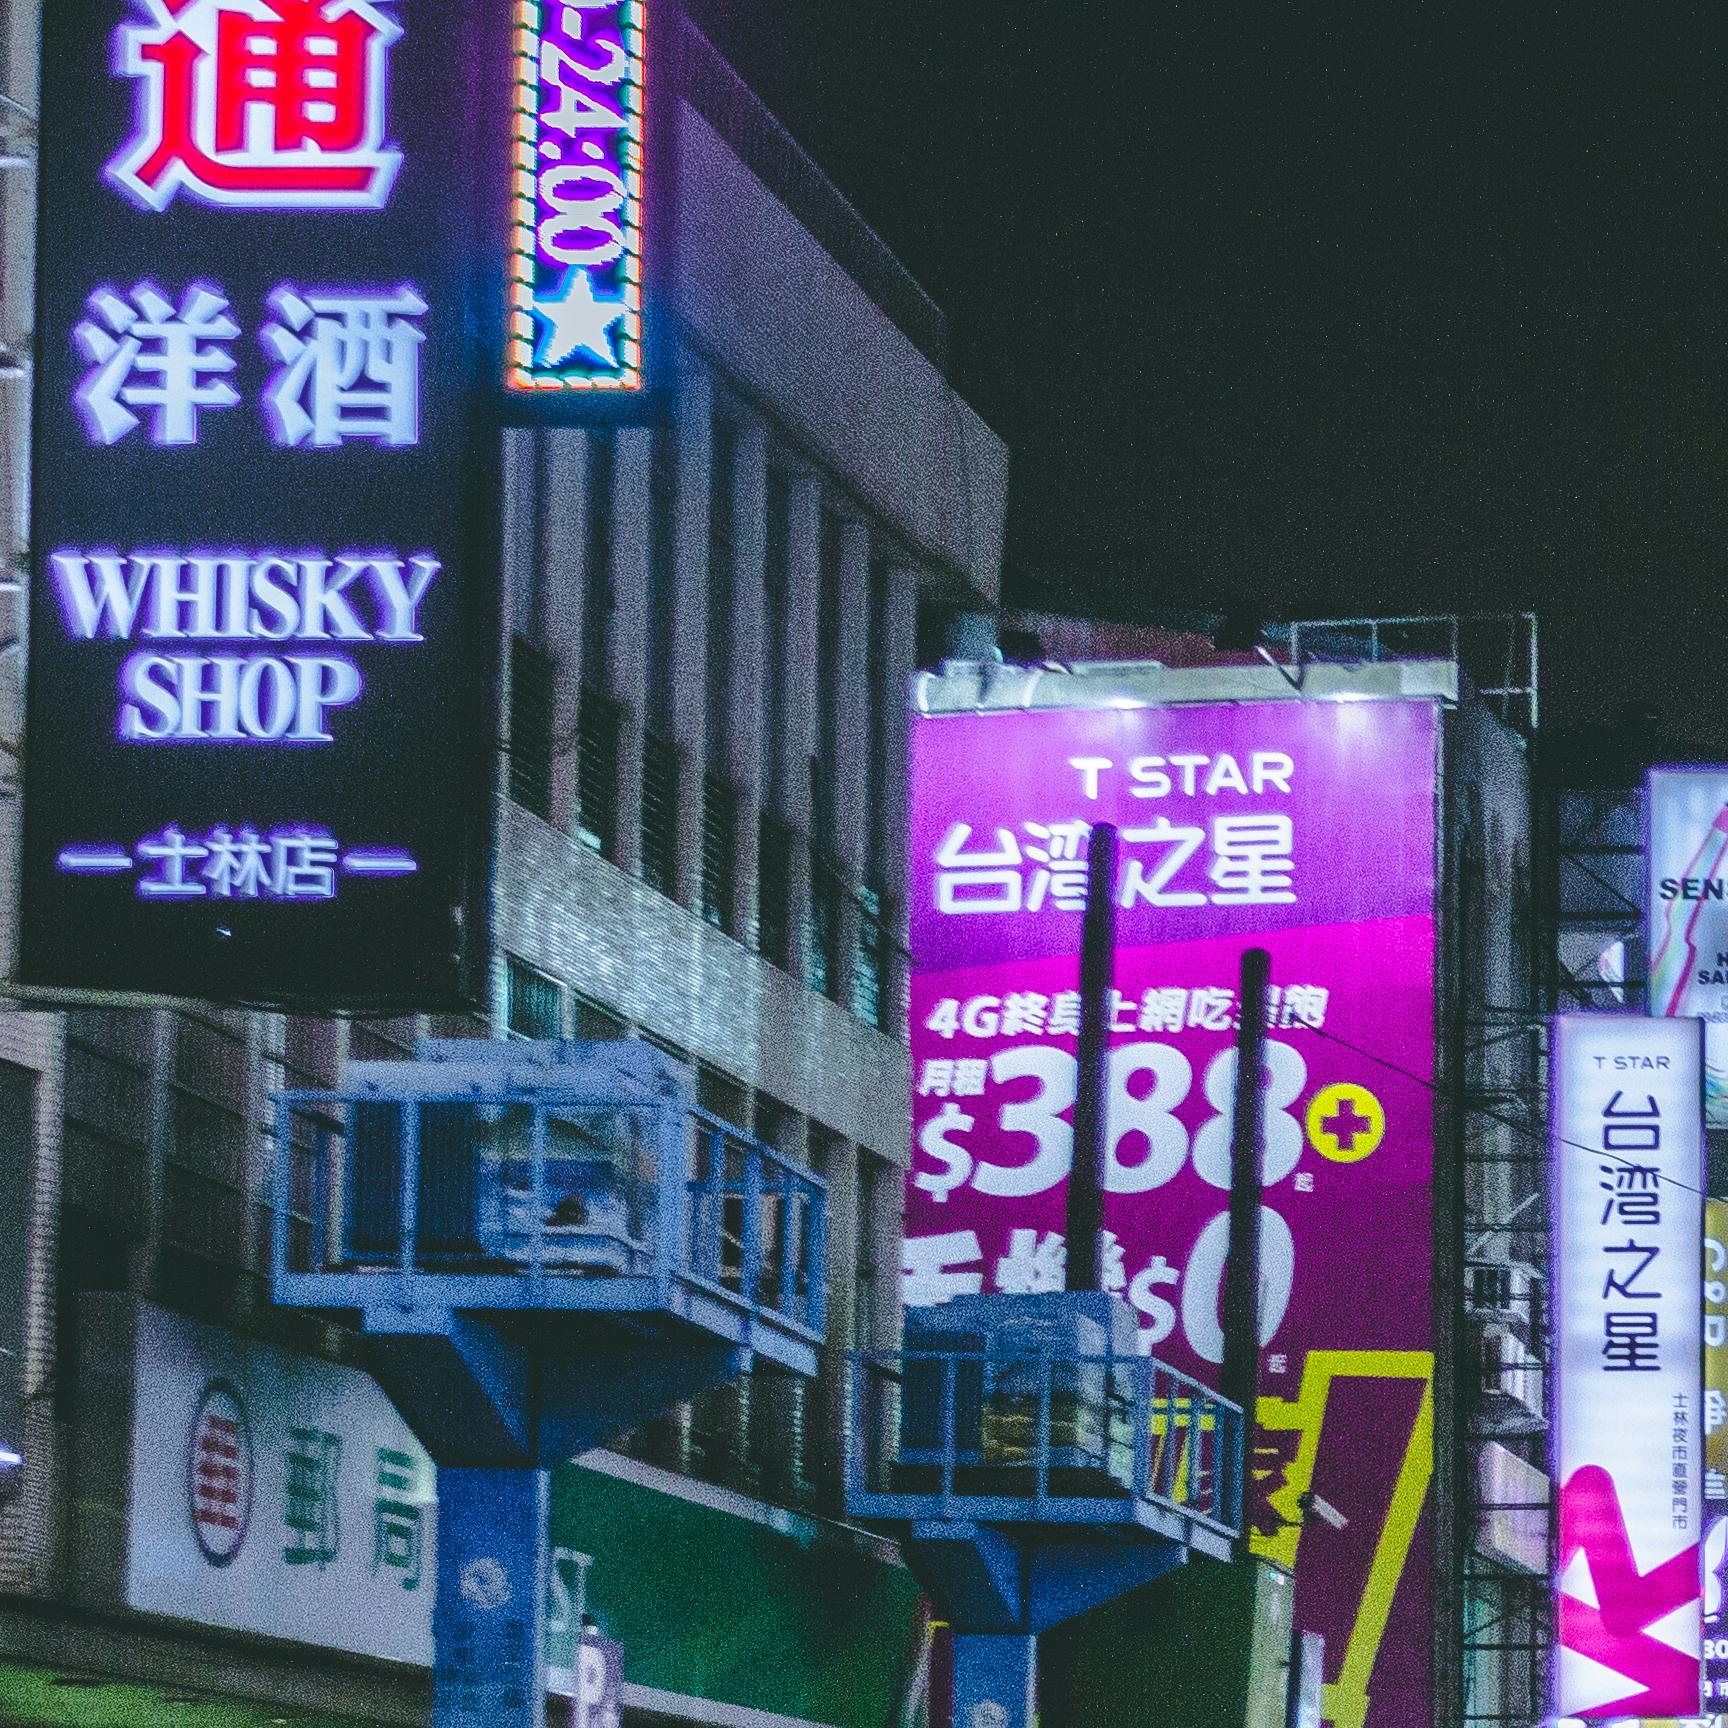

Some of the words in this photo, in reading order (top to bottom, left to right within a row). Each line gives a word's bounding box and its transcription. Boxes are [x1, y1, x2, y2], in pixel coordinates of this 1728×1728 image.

[82, 283, 429, 446] 洋酒
[51, 554, 441, 642] WHISKY
[122, 653, 360, 743] SHOP
[1070, 757, 1114, 800] T
[1130, 752, 1294, 799] STAR
[138, 829, 339, 898] 士林店
[1593, 1057, 1607, 1070] T
[1613, 1055, 1671, 1070] STAR
